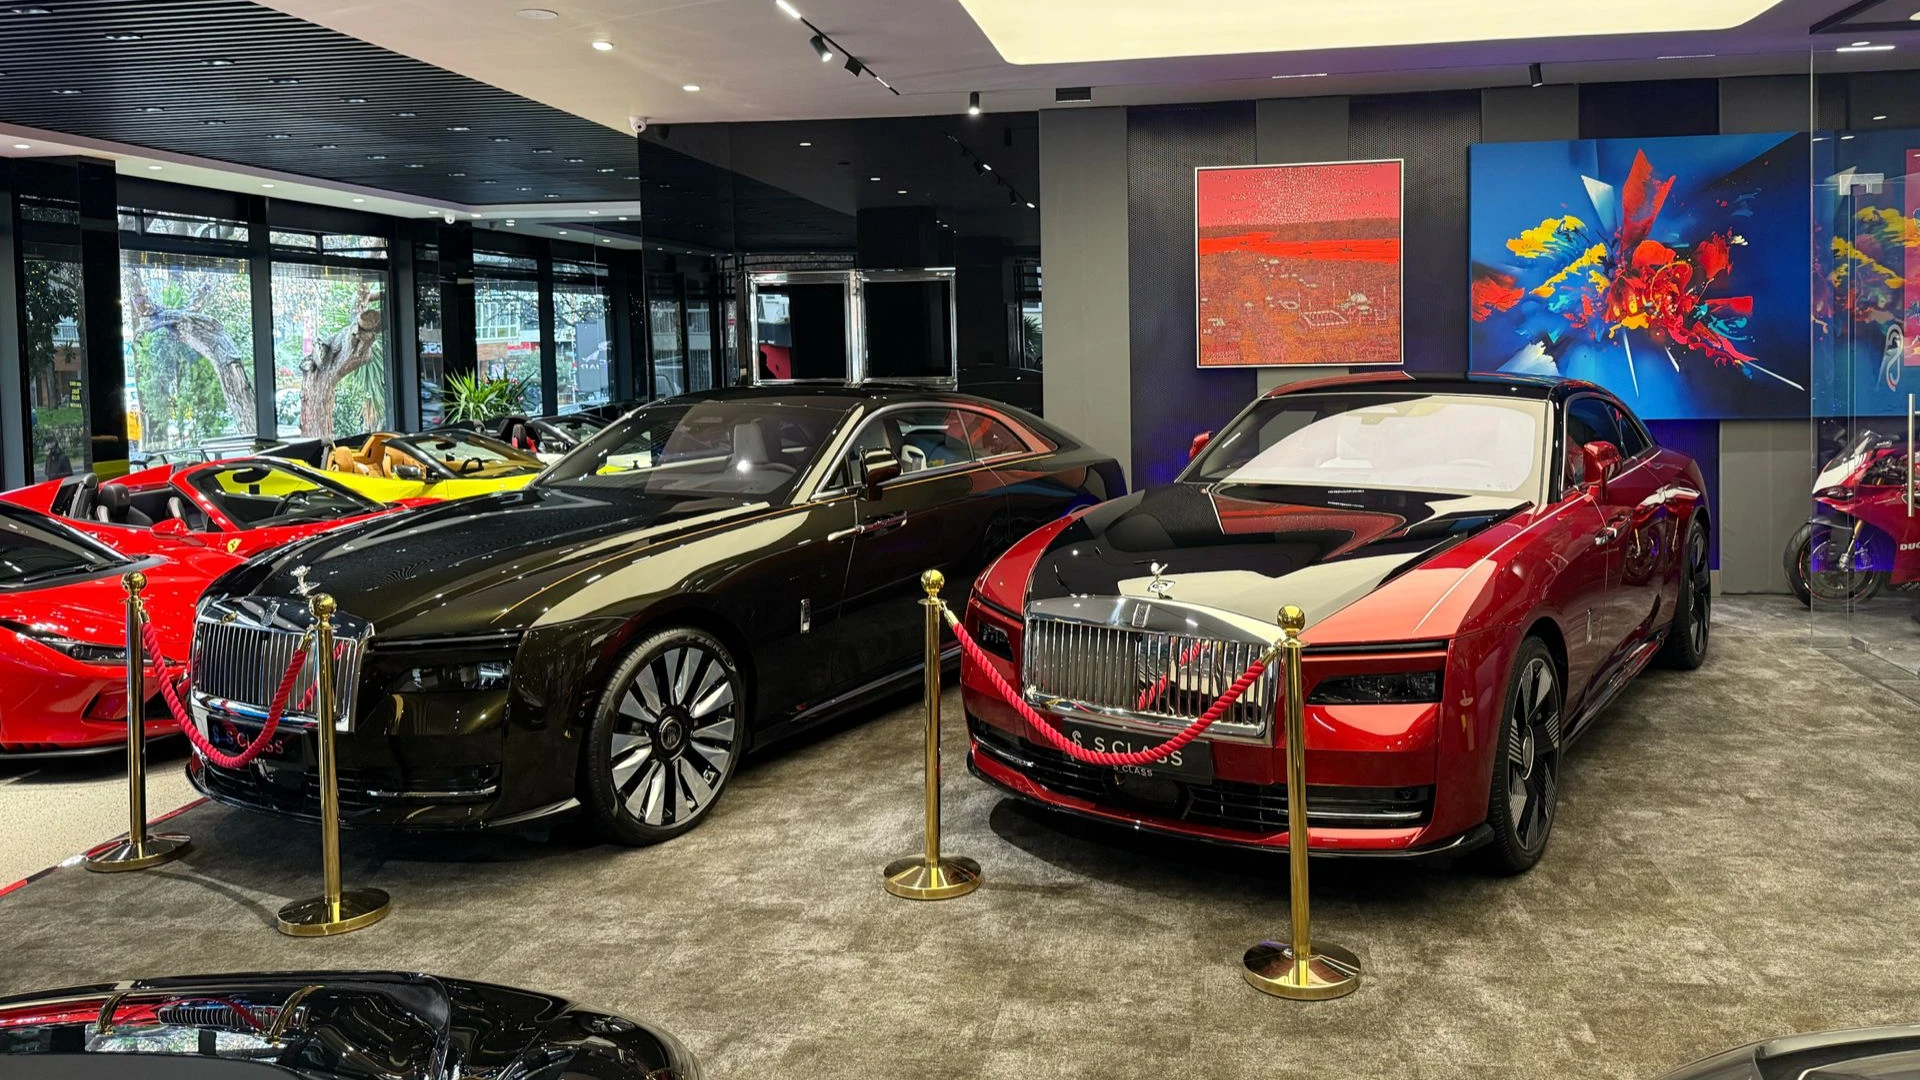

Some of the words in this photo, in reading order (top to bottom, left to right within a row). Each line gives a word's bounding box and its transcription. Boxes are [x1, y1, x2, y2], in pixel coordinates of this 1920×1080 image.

[237, 732, 284, 754] CLSS
[1094, 737, 1106, 753] S
[1122, 765, 1153, 777] CLASS
